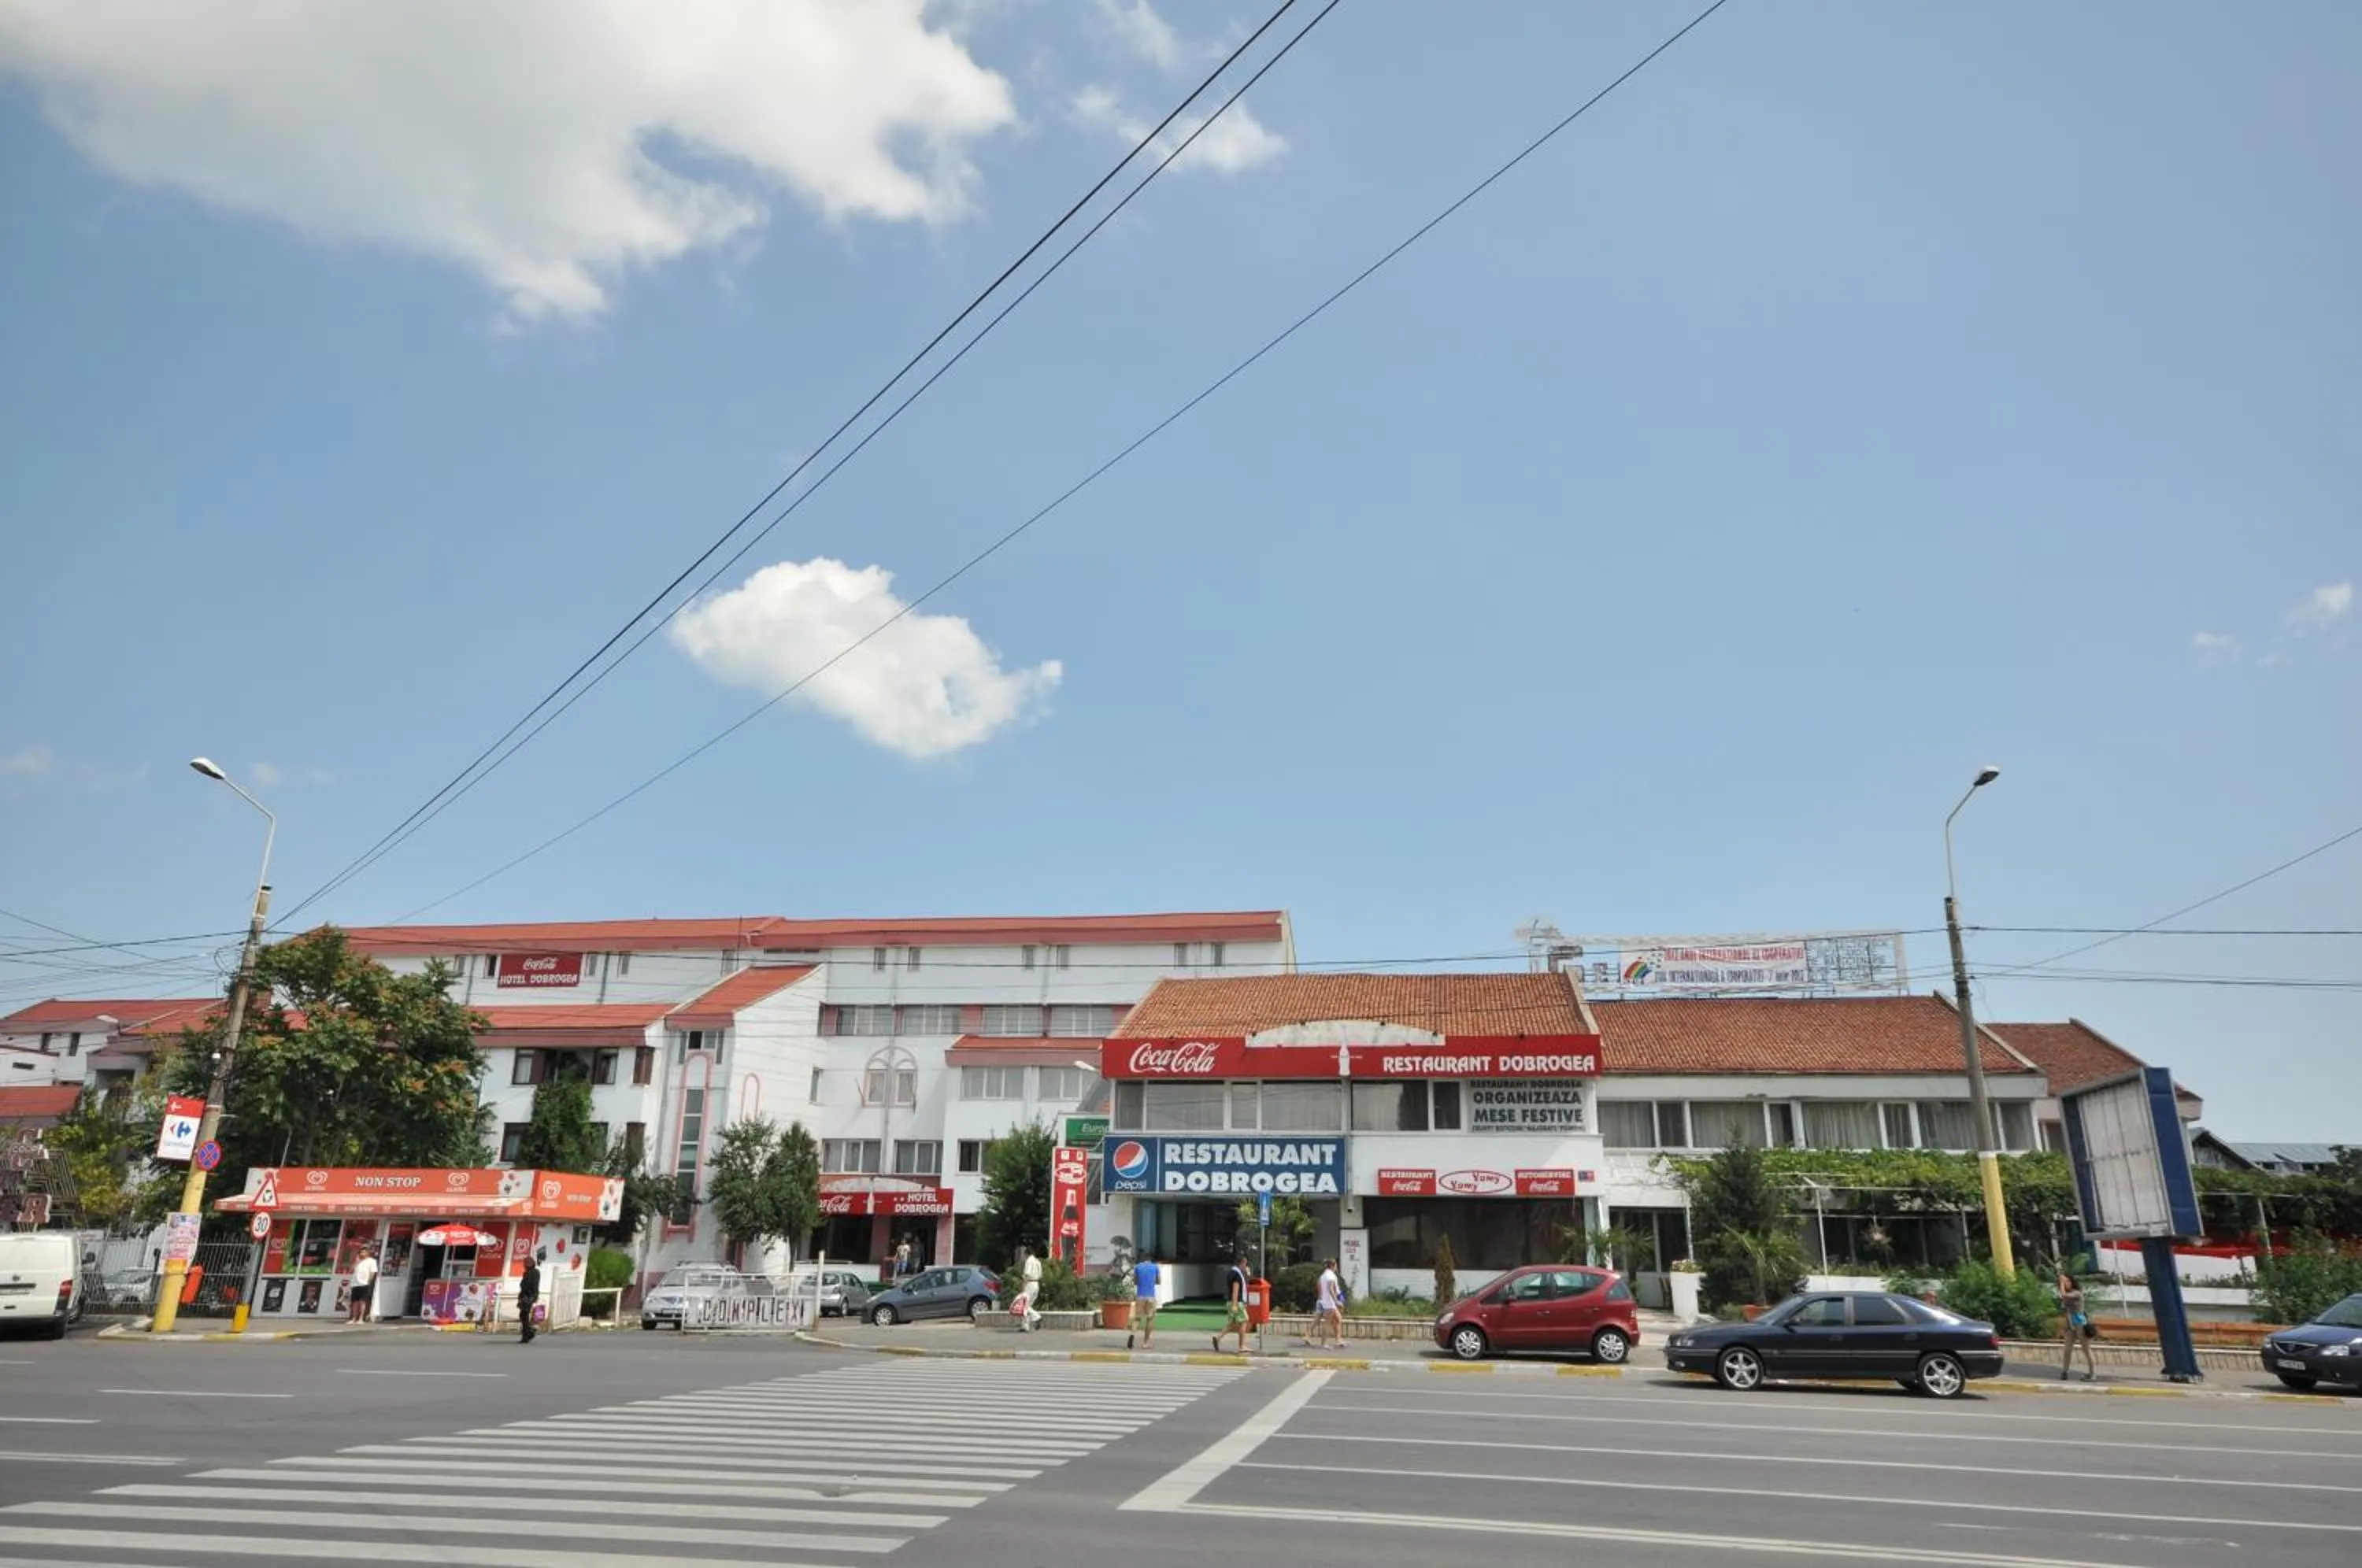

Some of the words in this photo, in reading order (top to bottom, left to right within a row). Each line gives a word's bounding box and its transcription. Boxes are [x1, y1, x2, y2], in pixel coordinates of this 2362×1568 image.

[500, 974, 526, 984] HOTEL
[530, 974, 578, 983] DOBROGEA
[1129, 1041, 1220, 1074] Coca-Cola
[1383, 1056, 1491, 1073] RESTAURANT
[1498, 1056, 1596, 1073] DOBROGEA
[1470, 1079, 1527, 1088] RESTAURANT
[1474, 1091, 1582, 1104] ORGANIZEAZA
[1474, 1108, 1516, 1123] MESE
[1522, 1108, 1583, 1123] FESTIVE
[1164, 1144, 1336, 1165] RESTAURANT
[354, 1177, 384, 1188] NON
[387, 1177, 422, 1188] STOP
[1115, 1181, 1146, 1191] pepsi
[1164, 1171, 1338, 1193] DOBROGEA
[908, 1193, 938, 1202] HOTEL
[894, 1204, 949, 1214] DOBROGEA
[255, 1217, 268, 1233] 30
